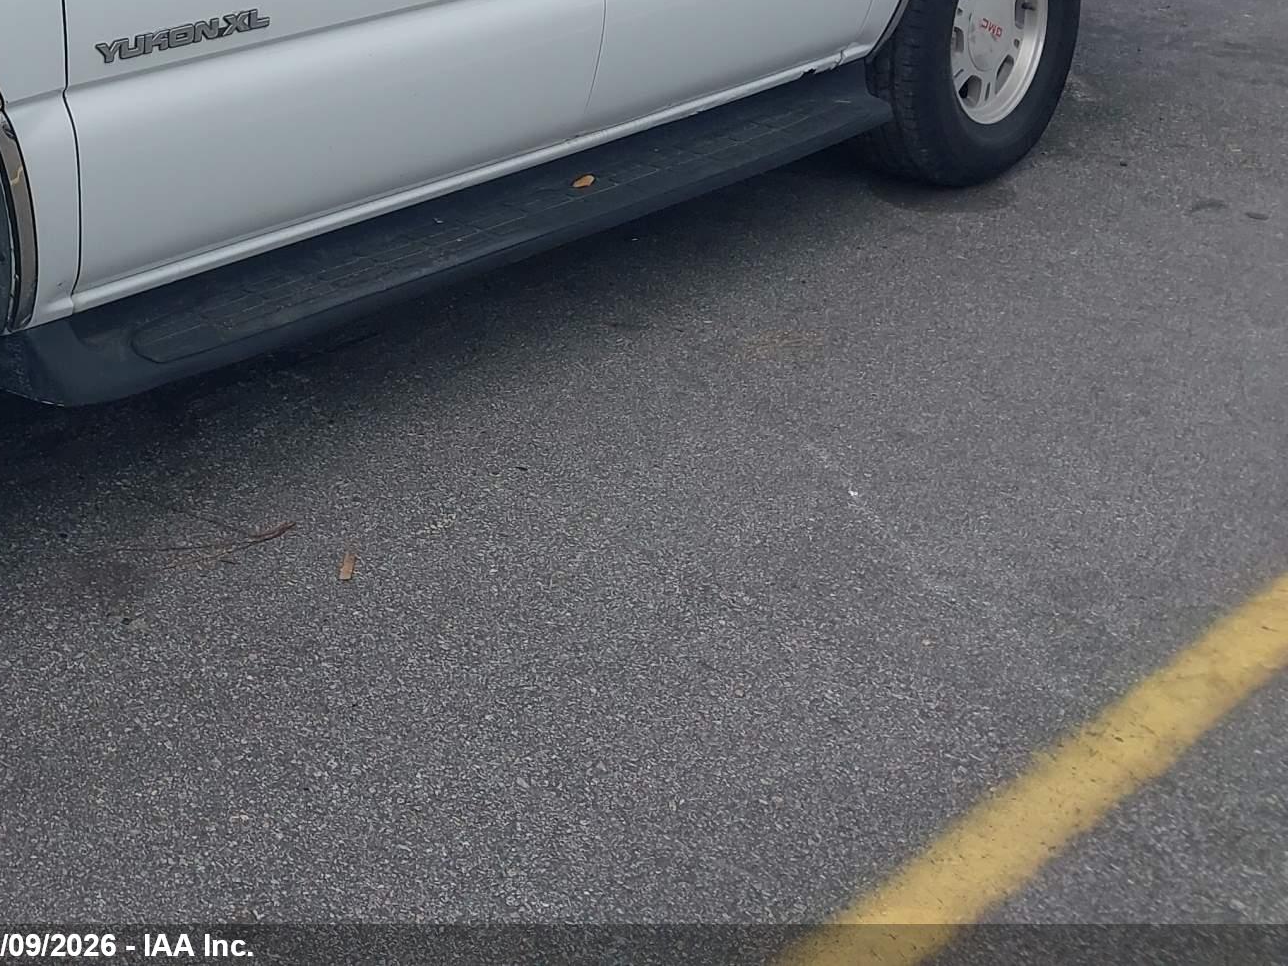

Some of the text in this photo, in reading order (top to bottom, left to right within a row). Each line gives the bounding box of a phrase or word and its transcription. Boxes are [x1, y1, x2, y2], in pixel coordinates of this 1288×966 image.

[96, 8, 270, 63] YUKON XL
[981, 18, 1003, 38] GMC
